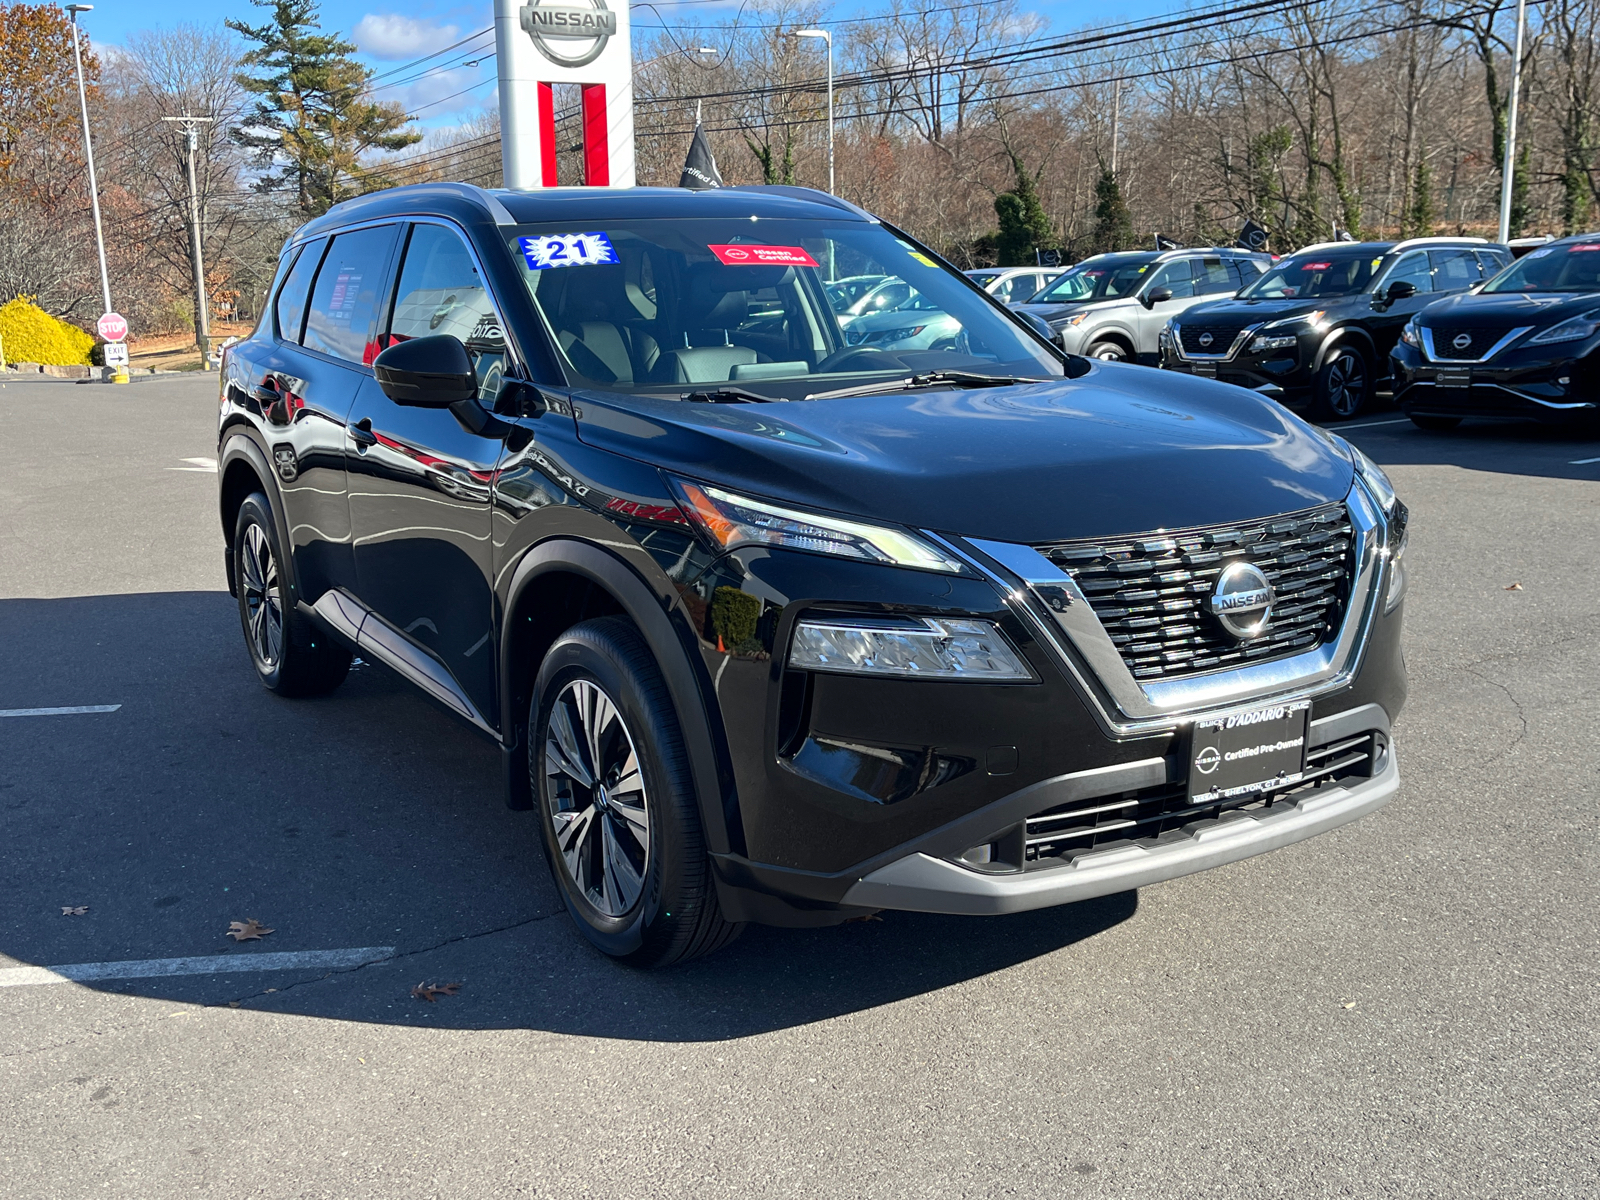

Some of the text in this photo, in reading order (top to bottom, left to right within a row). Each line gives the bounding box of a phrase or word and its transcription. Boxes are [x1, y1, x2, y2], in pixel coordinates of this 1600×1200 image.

[531, 11, 609, 29] NISSAN
[546, 239, 588, 261] 21
[100, 322, 125, 333] STOP
[1221, 591, 1270, 610] NISSAN
[1226, 707, 1285, 729] D'ADDARIO
[1224, 736, 1304, 761] Certified Pre-Owned
[1194, 755, 1221, 764] NISSAN
